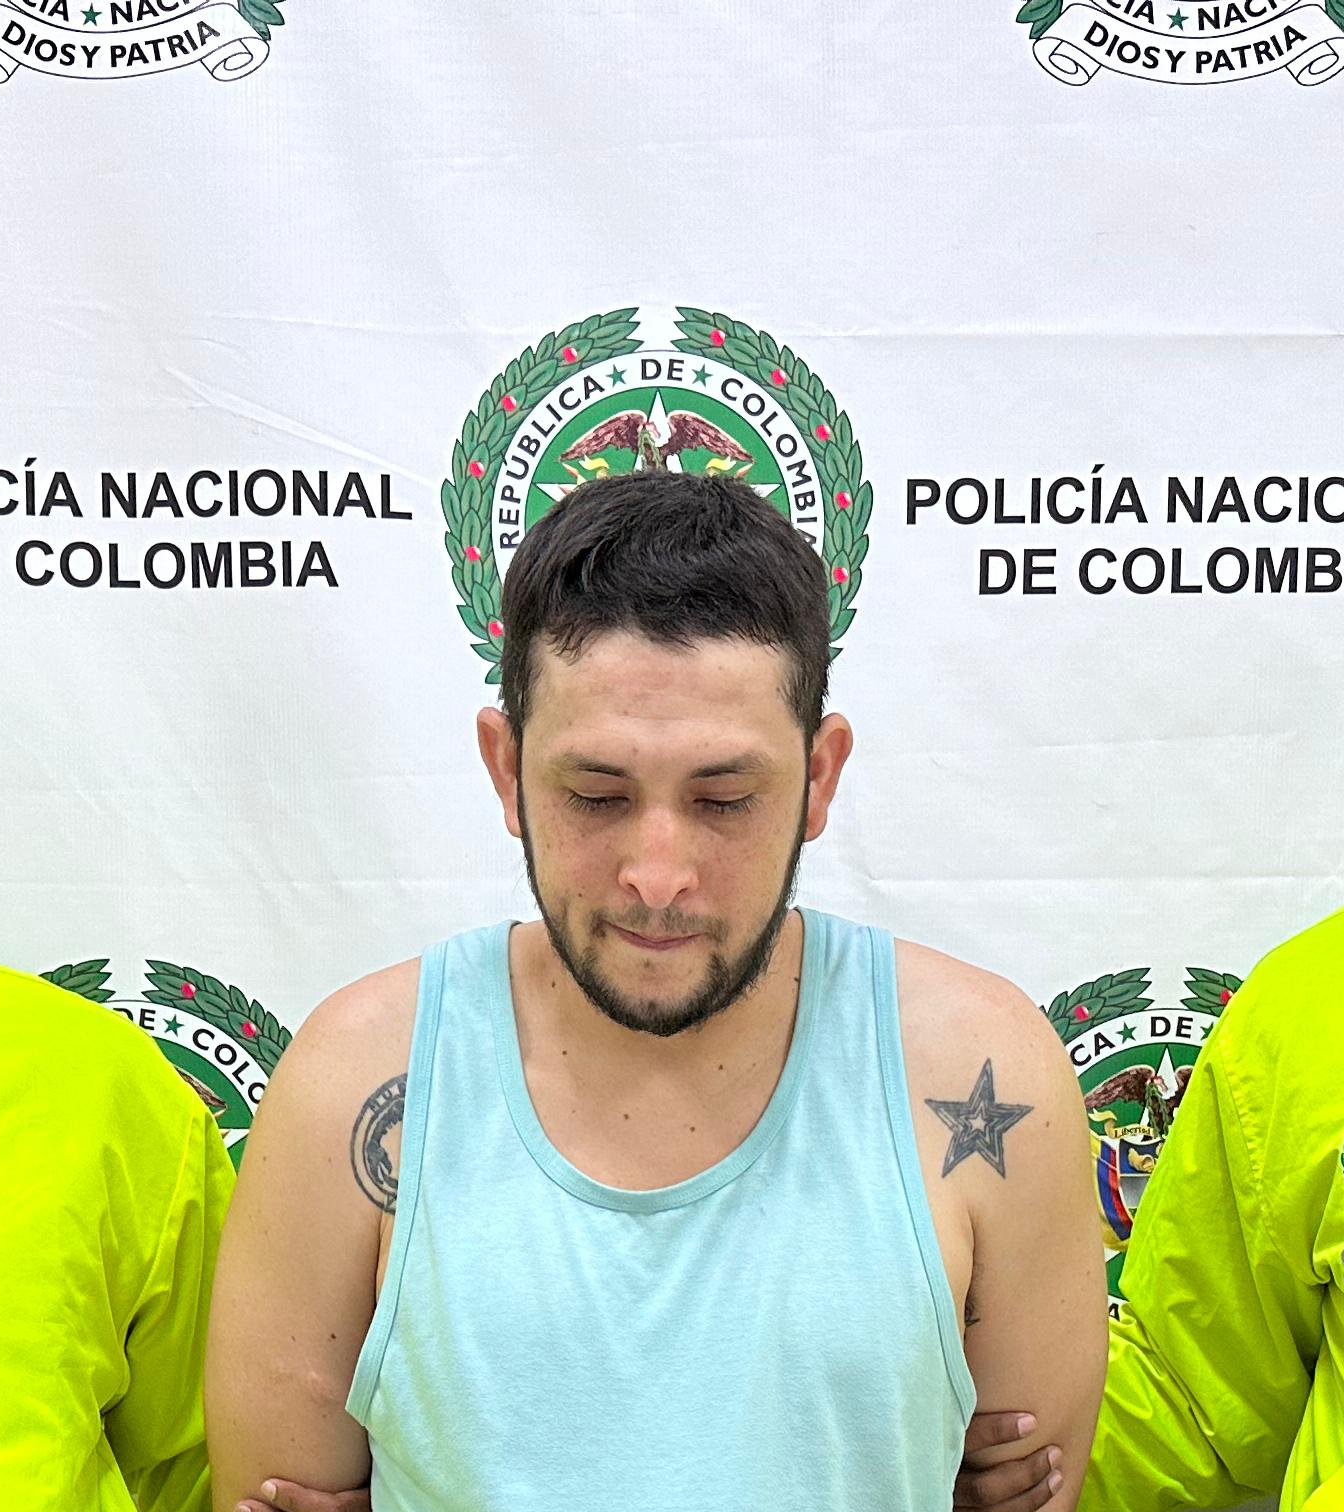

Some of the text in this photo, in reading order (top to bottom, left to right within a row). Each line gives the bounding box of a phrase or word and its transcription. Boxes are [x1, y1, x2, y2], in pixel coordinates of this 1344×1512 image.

[111, 20, 221, 68] PATRIA
[1196, 24, 1308, 73] PATRIA
[499, 375, 605, 549] REPÚBLICA
[640, 358, 685, 382] DE
[101, 469, 413, 520] NACIONAL
[906, 463, 1148, 525] POLICÍA
[15, 540, 339, 589] COLOMBIA
[978, 548, 1057, 595] DE
[1150, 1016, 1194, 1039] DE
